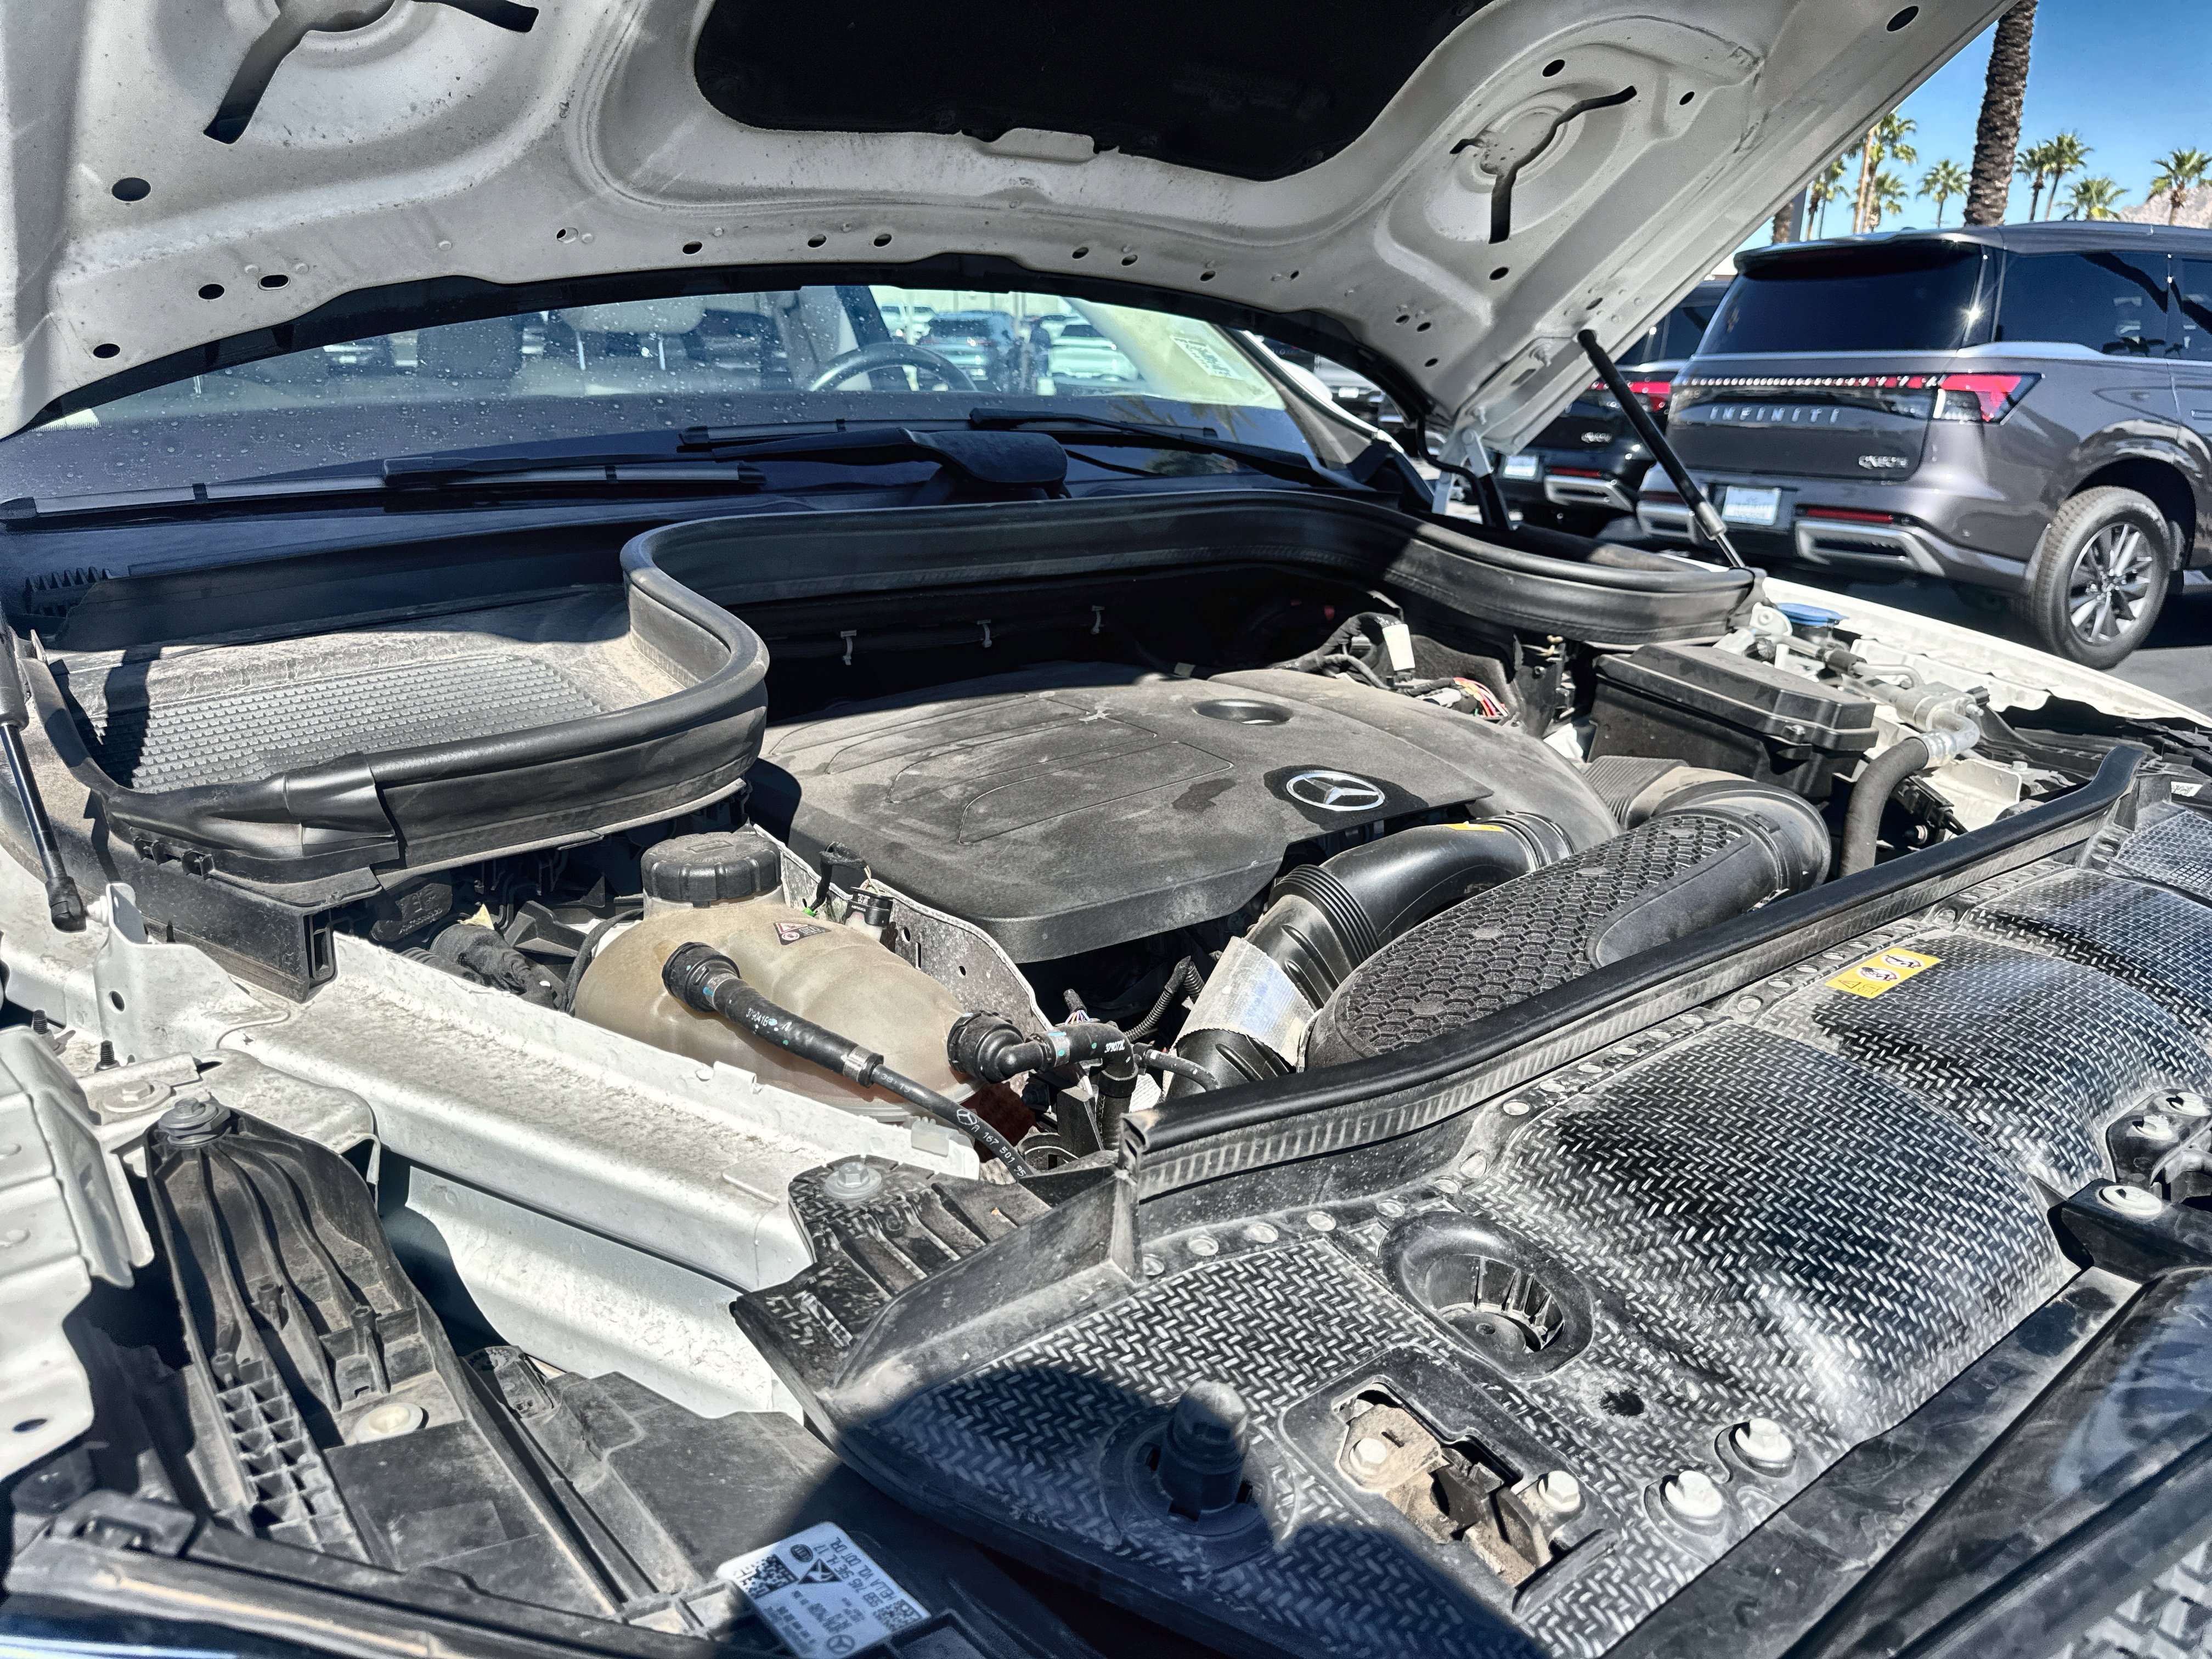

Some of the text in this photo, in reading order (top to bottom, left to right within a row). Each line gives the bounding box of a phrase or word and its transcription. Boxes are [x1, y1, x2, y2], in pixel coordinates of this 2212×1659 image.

[1709, 407, 1839, 422] INFINITI
[983, 1132, 999, 1145] 167
[1000, 1146, 1015, 1163] 501
[842, 1552, 861, 1566] DOT
[871, 1578, 896, 1600] HELLA
